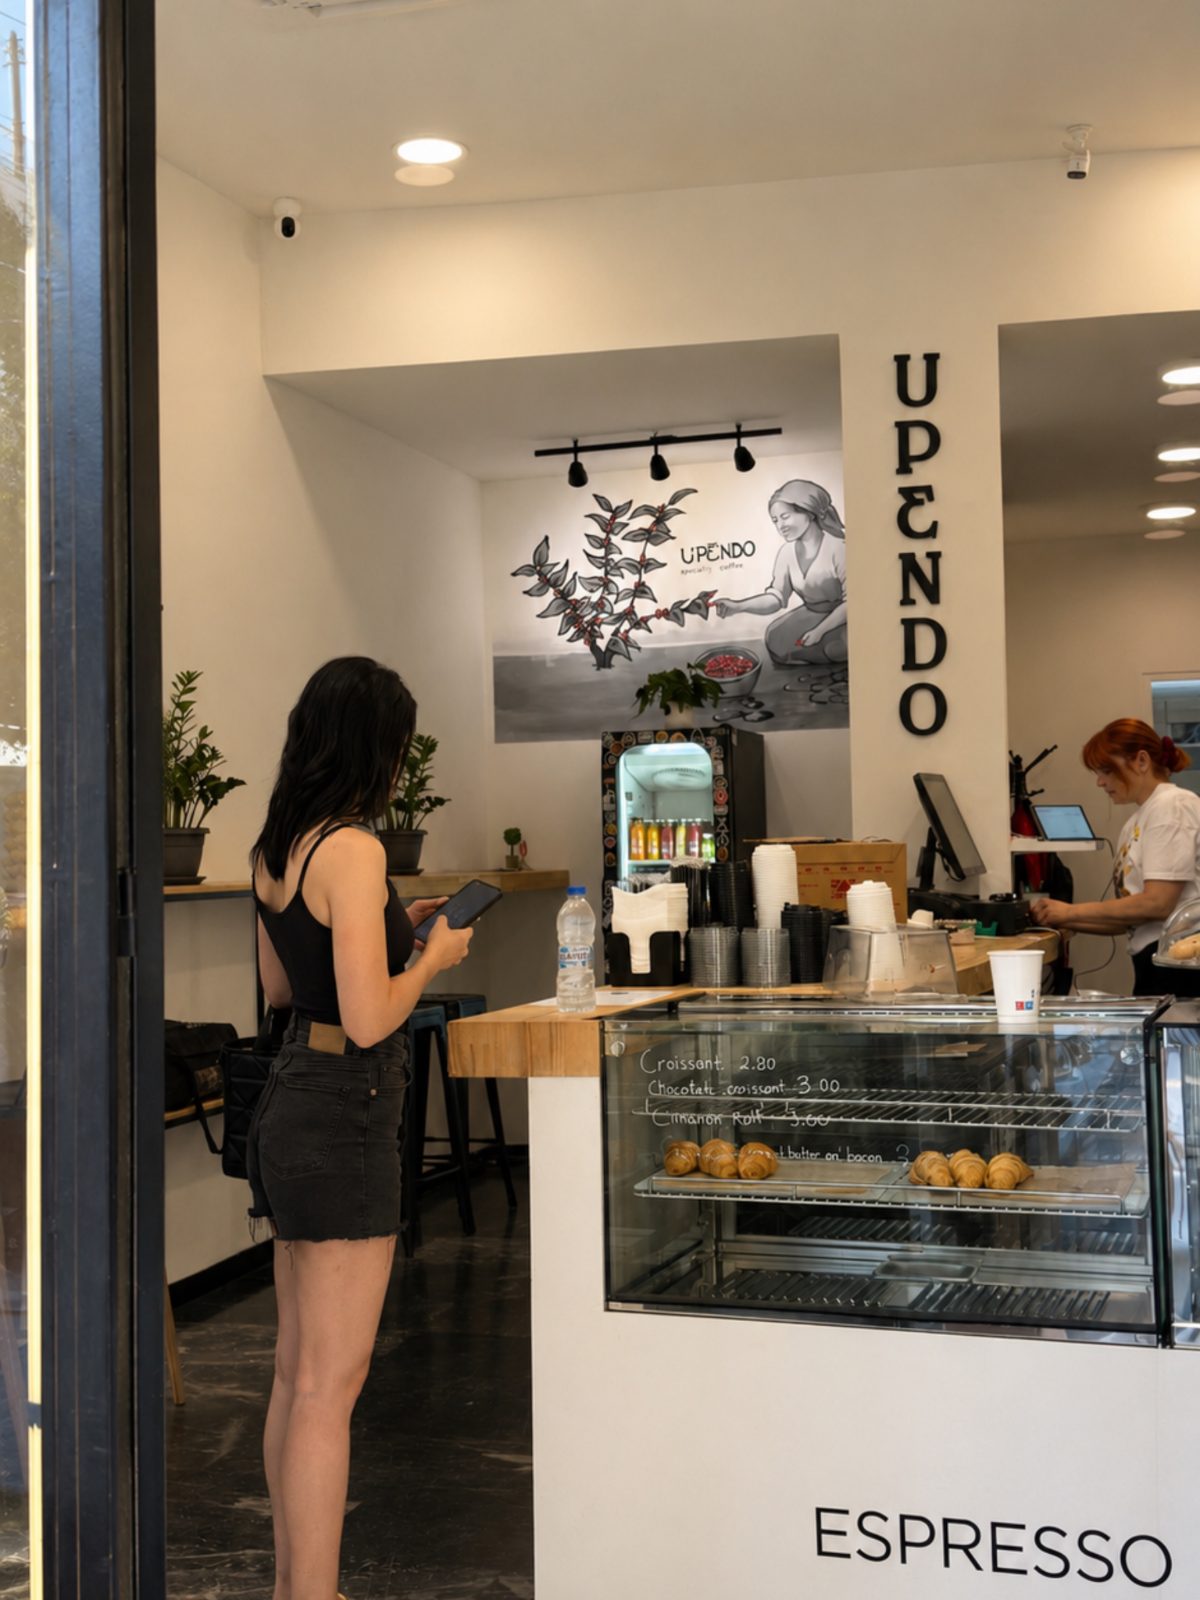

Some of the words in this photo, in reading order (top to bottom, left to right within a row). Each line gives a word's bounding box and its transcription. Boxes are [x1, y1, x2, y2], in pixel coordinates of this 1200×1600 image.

[680, 540, 756, 565] UPENDO
[893, 353, 948, 736] UPENDO
[740, 1056, 776, 1072] 2.80
[815, 1507, 1172, 1588] ESPRESSO
